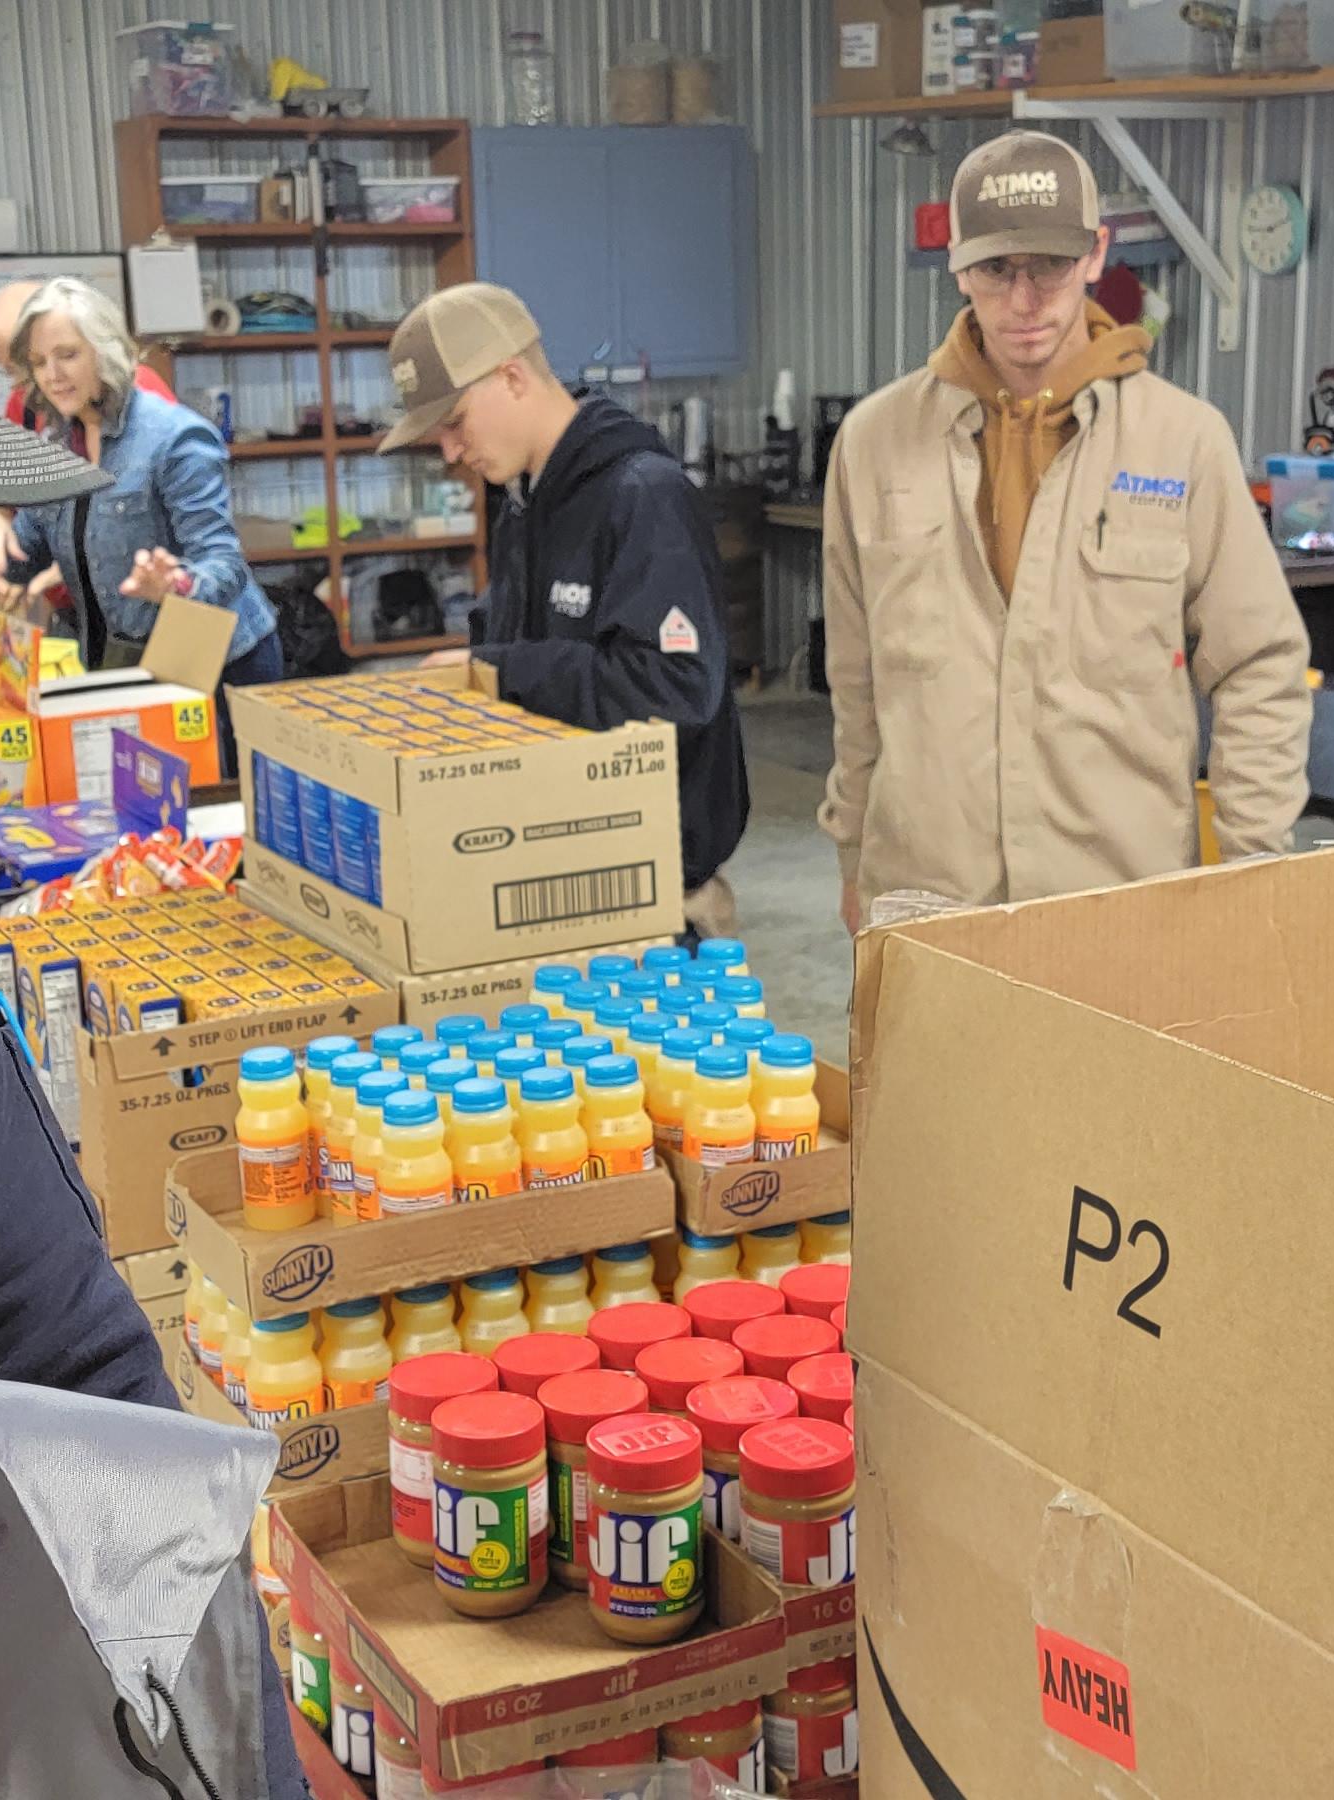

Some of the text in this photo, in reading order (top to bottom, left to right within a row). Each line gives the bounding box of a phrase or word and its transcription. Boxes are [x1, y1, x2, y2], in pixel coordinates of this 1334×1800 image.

[977, 169, 1058, 201] ATMOS
[1110, 471, 1185, 497] ATMOS
[179, 706, 204, 724] 45
[0, 726, 28, 745] 45
[419, 758, 522, 783] 35-7.25 OZ PKGS
[586, 757, 665, 780] 01871.00
[463, 832, 505, 848] KRAFT
[420, 978, 522, 1004] 35-7.25 OZ PKGS
[188, 1031, 220, 1048] STEP
[240, 1023, 265, 1040] LIFT
[269, 1018, 294, 1035] END
[297, 1013, 327, 1032] FLAP
[120, 1093, 172, 1113] 35-7.25
[197, 1082, 231, 1099] PKGS
[178, 1130, 218, 1147] KRAFT
[722, 1171, 780, 1210] SUNNYD
[262, 1245, 334, 1297] SUNNYD
[1063, 1185, 1170, 1339] P2
[588, 1514, 690, 1583] Jif
[812, 1596, 853, 1621] 16 O
[603, 1669, 639, 1697] Jif
[1043, 1649, 1131, 1737] HEAVY
[483, 1692, 544, 1721] 16 OZ
